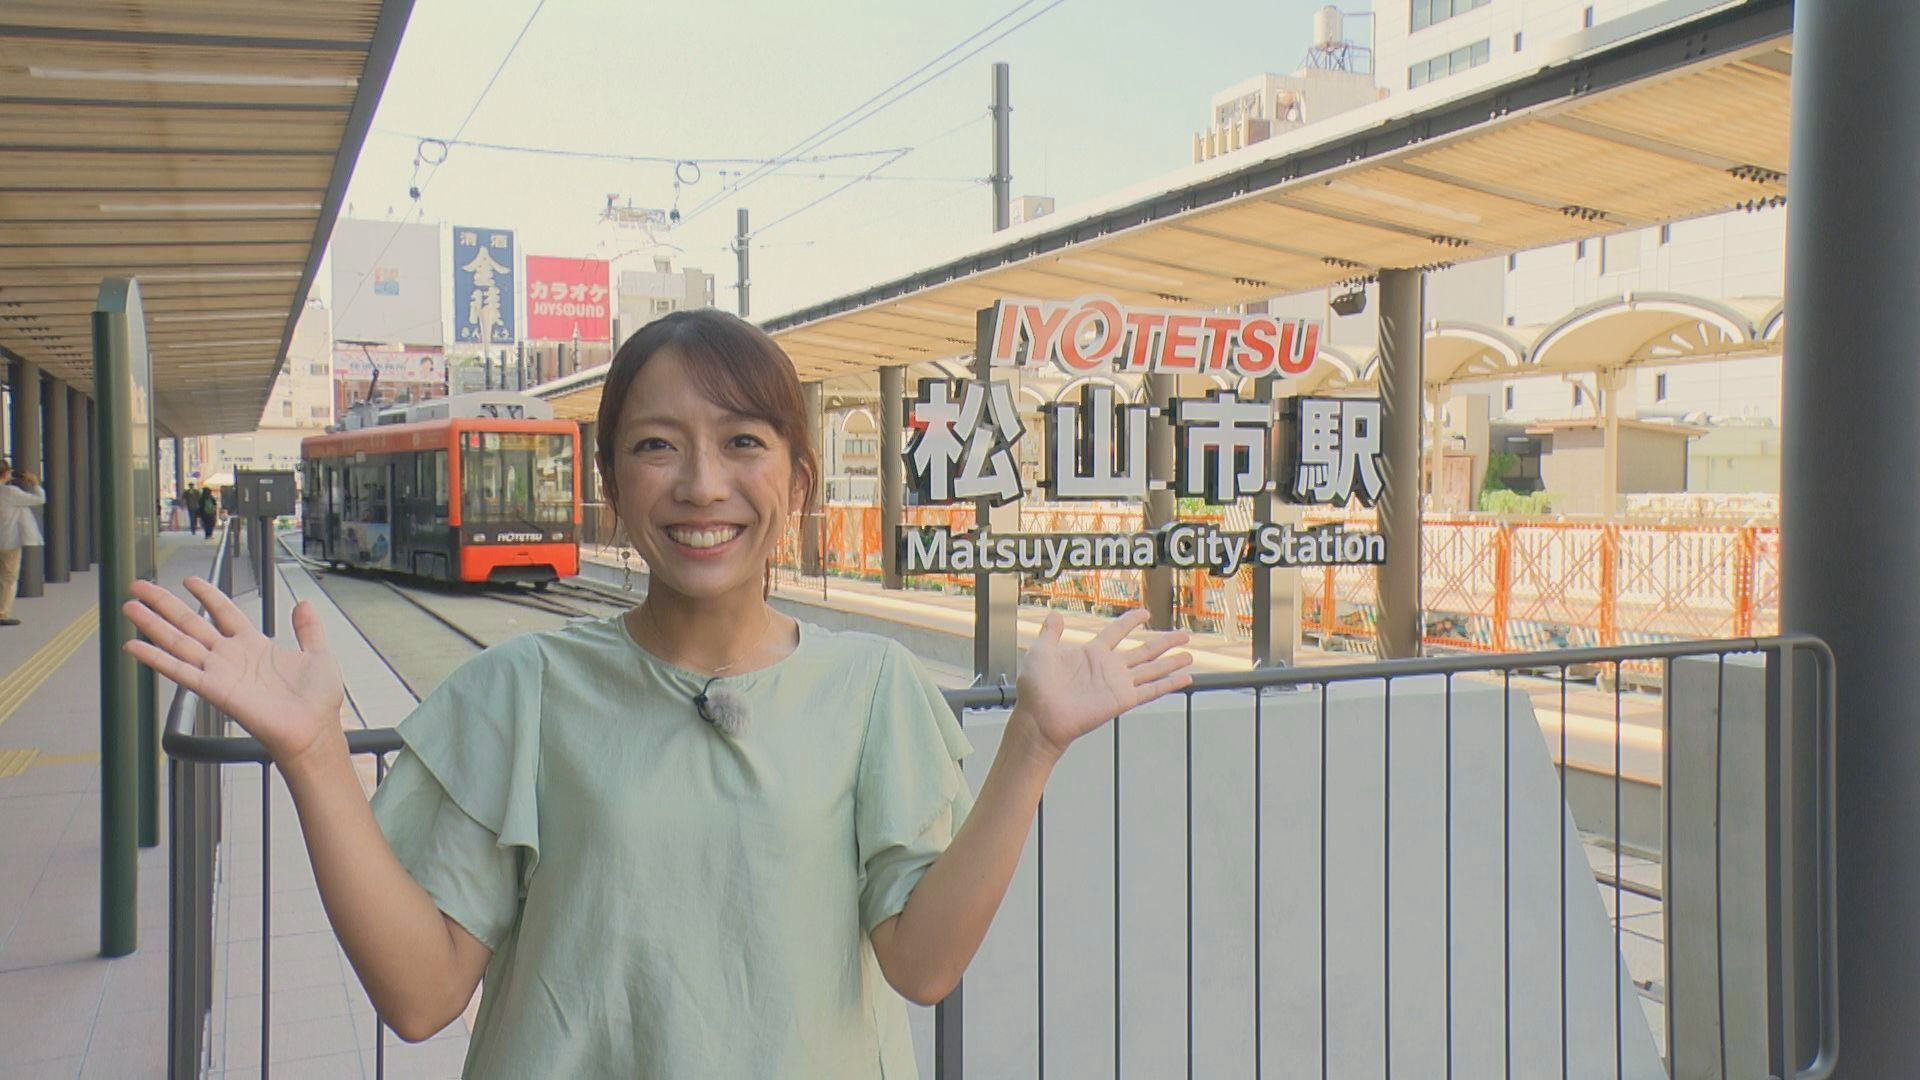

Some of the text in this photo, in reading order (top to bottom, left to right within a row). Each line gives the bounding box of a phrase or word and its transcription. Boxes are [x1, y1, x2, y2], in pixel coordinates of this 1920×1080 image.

[529, 280, 608, 302] カラオケ
[533, 302, 605, 318] JOYSOUND
[992, 298, 1322, 376] IYOTETSU
[912, 381, 1384, 504] 松山市駅
[907, 526, 1386, 578] Matsuyama City Station
